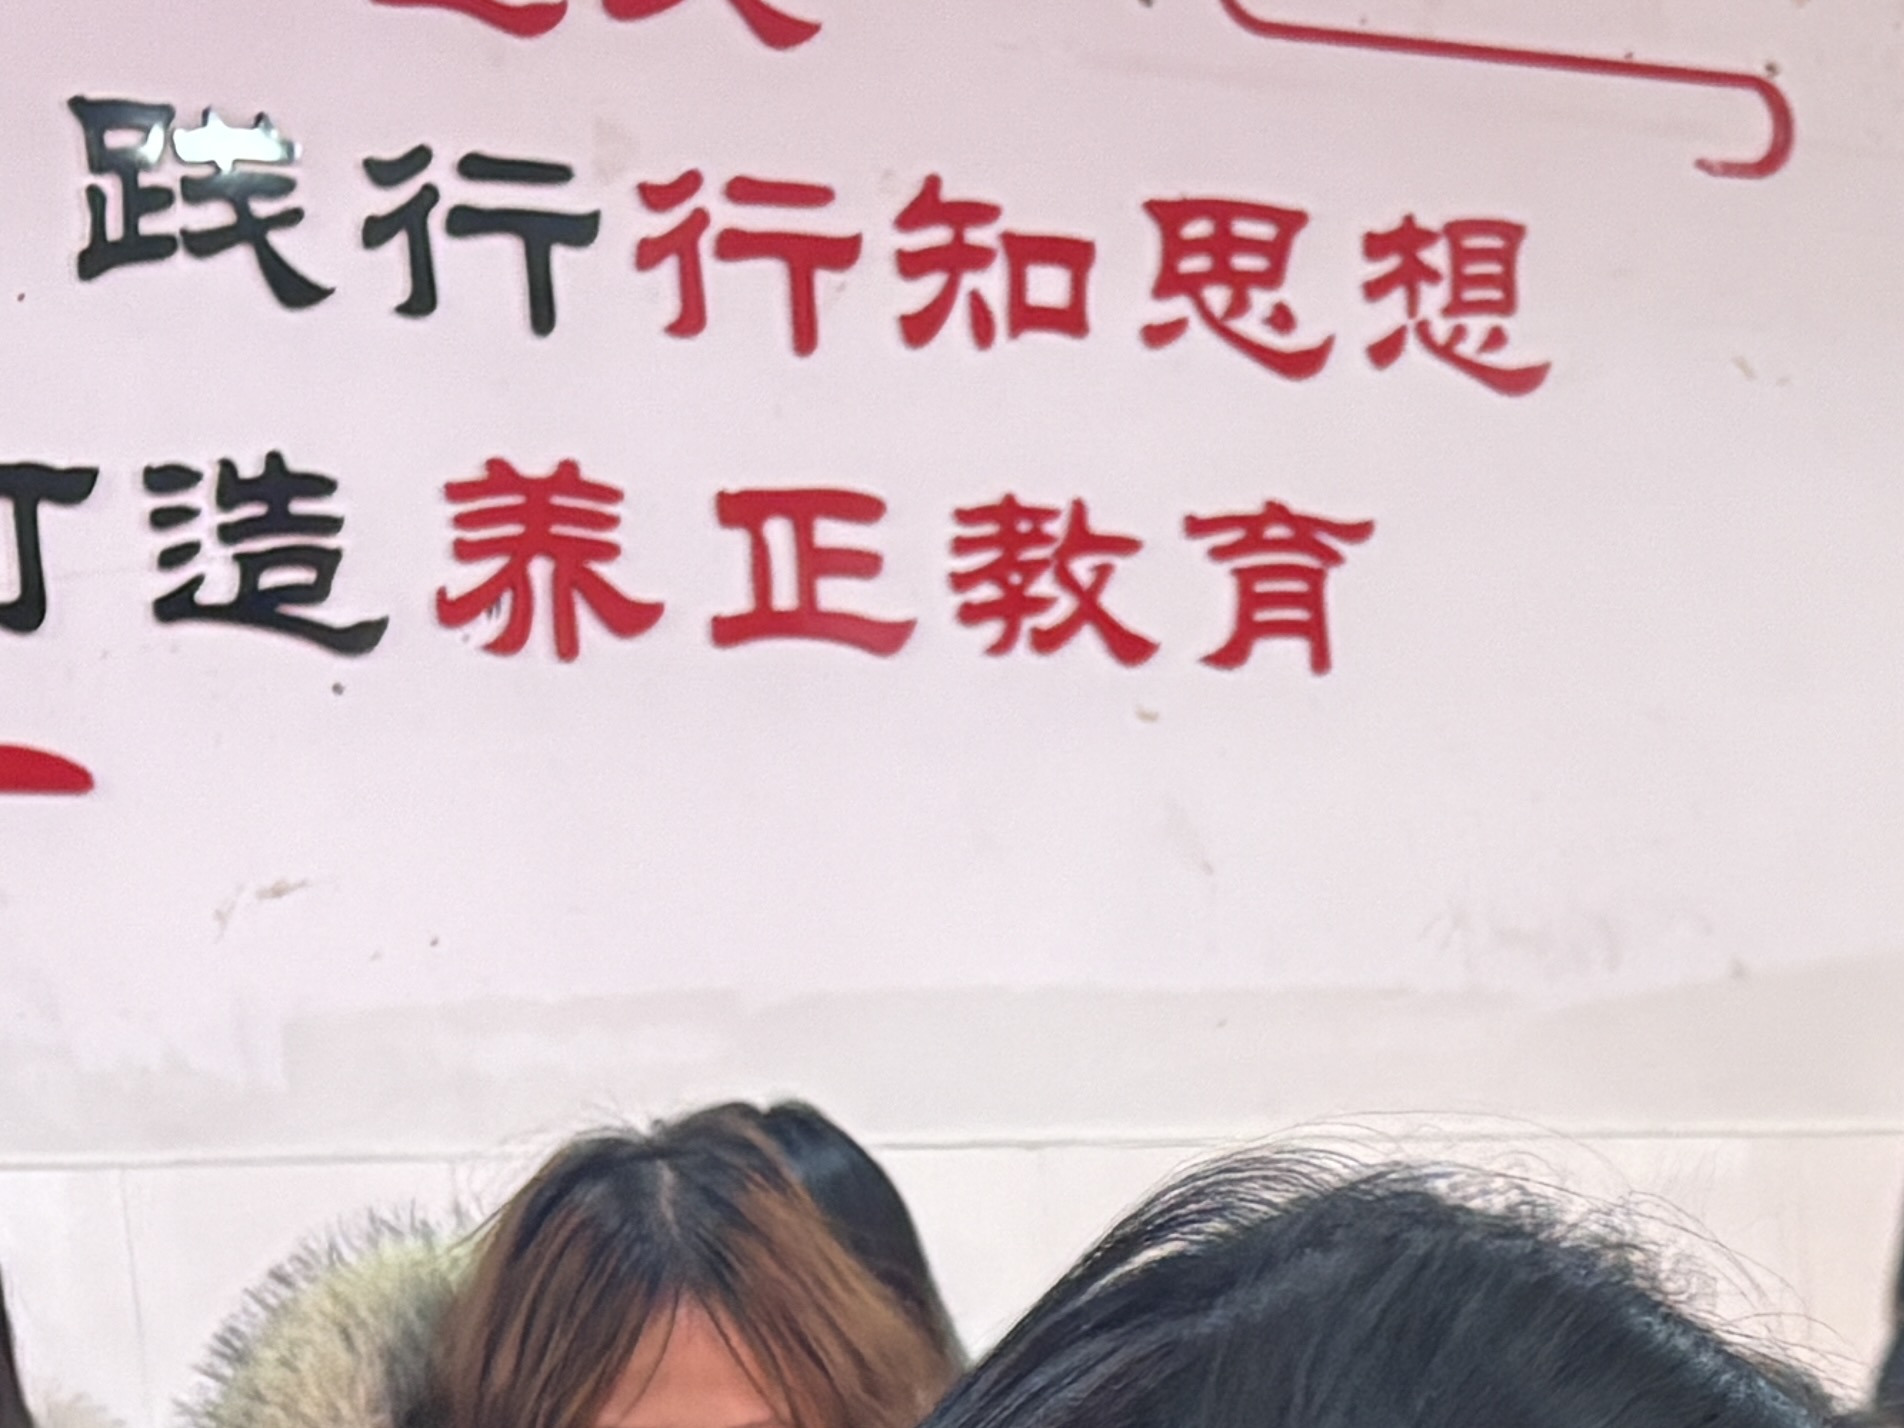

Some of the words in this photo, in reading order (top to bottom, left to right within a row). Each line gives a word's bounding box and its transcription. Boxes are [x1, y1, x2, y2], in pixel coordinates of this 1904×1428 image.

[67, 95, 1549, 395] 践行行知思想
